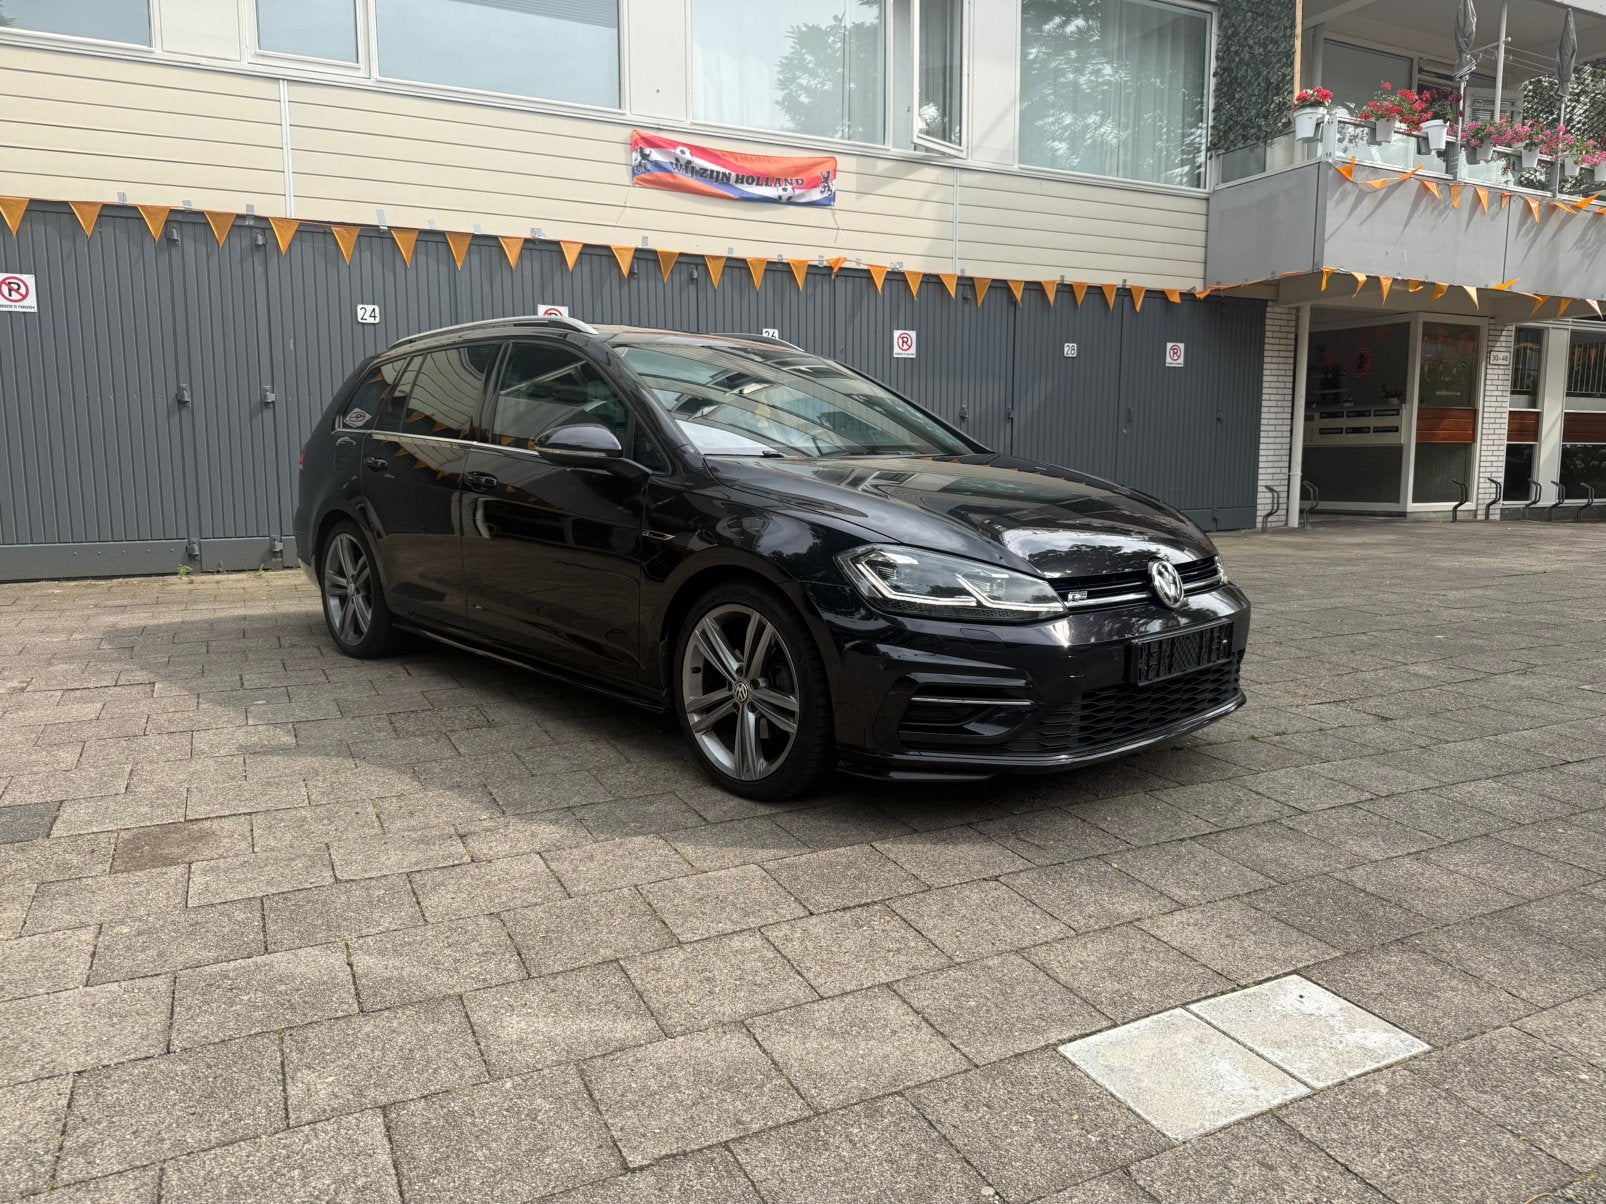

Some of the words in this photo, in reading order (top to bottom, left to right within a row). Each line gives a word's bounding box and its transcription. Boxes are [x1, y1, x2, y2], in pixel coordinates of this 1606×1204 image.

[699, 167, 732, 184] ZIJN
[734, 173, 806, 187] HOLLAND
[359, 306, 378, 321] 24
[1065, 344, 1076, 356] 28
